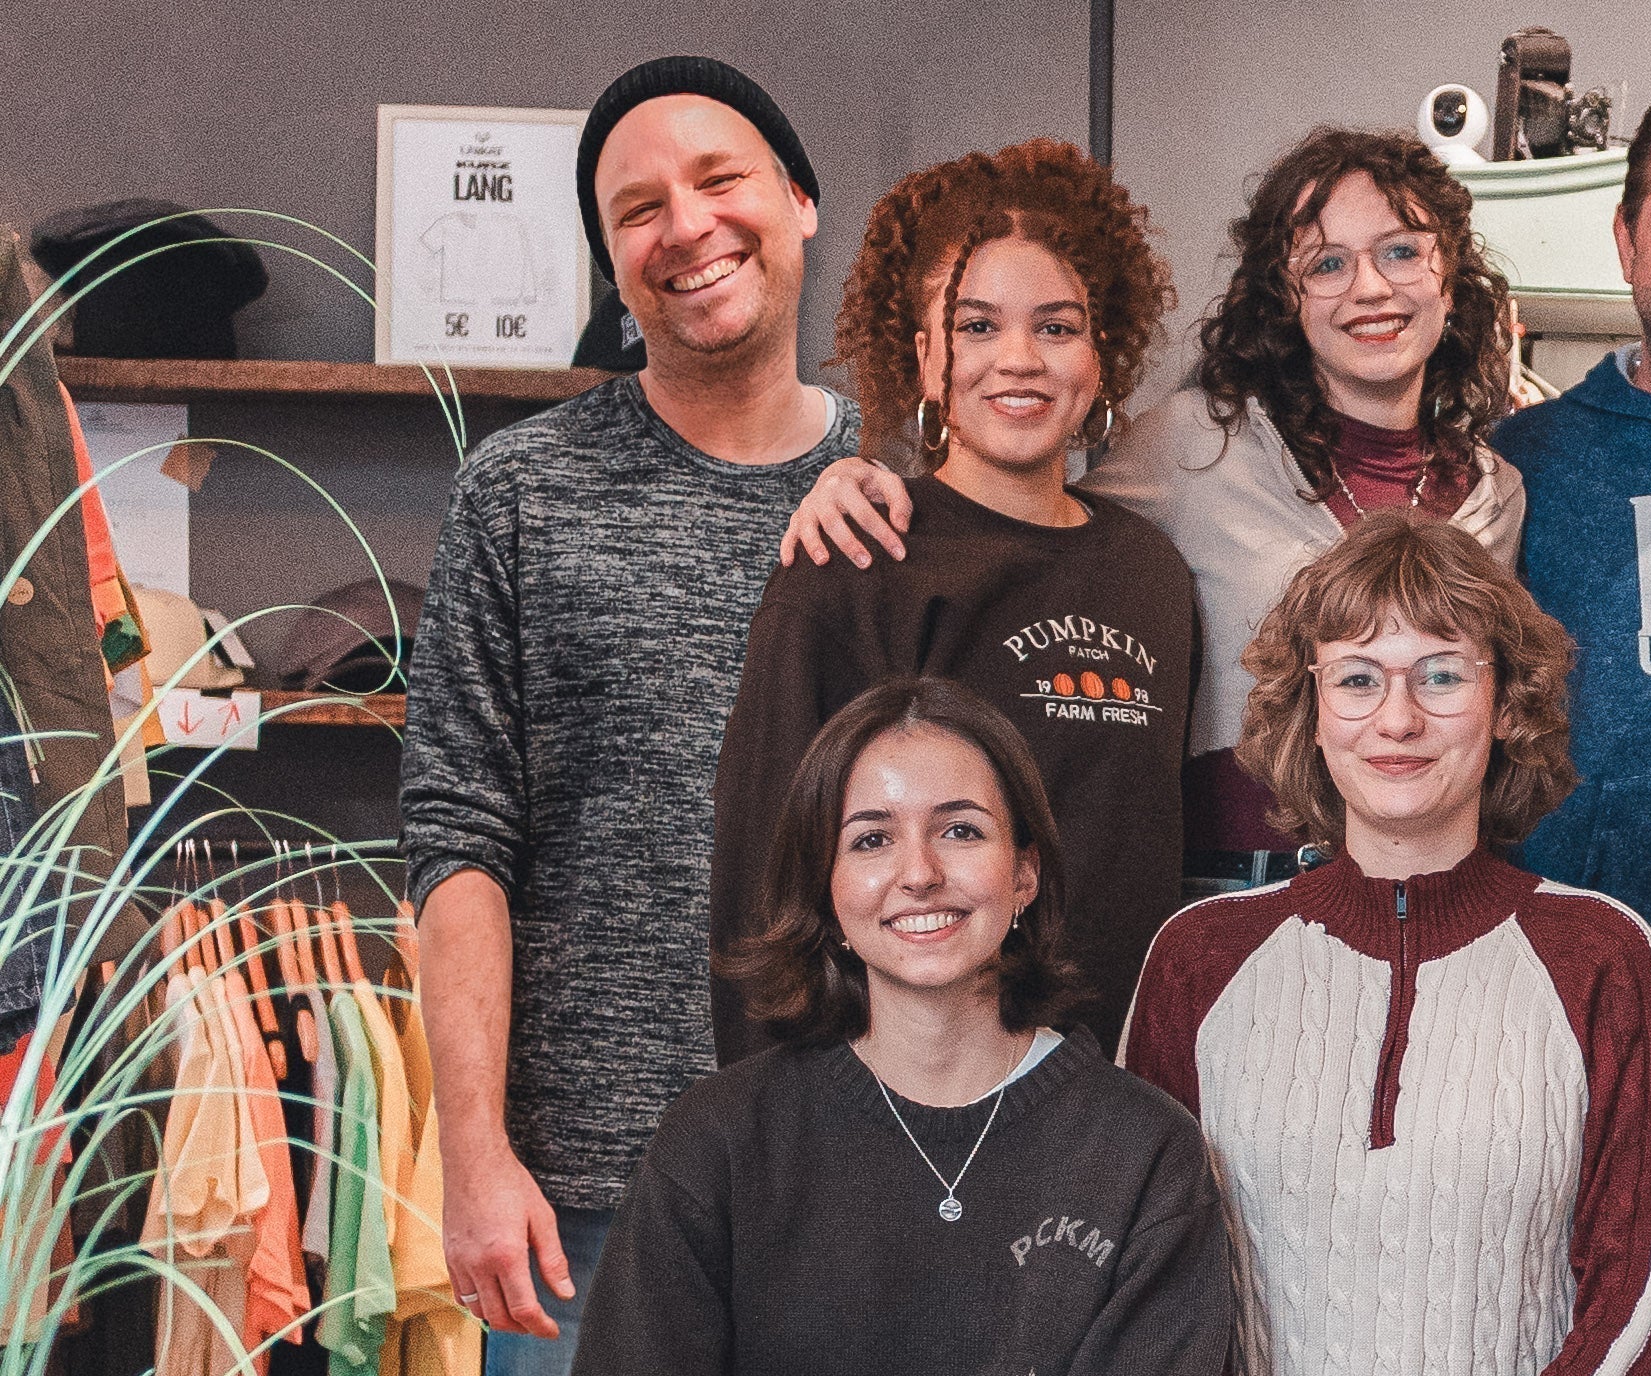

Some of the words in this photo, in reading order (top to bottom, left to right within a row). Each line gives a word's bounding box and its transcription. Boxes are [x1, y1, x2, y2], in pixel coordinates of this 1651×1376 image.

[453, 173, 513, 203] LANG
[445, 312, 469, 337] 5€
[496, 314, 527, 338] 10€
[1002, 614, 1158, 676] PUMPKIN
[1068, 644, 1110, 661] PATCH
[1036, 679, 1052, 695] 19
[1134, 688, 1149, 704] 98
[1045, 701, 1096, 722] FARM
[1102, 706, 1149, 726] FRESH
[1009, 1216, 1116, 1268] PCKM
